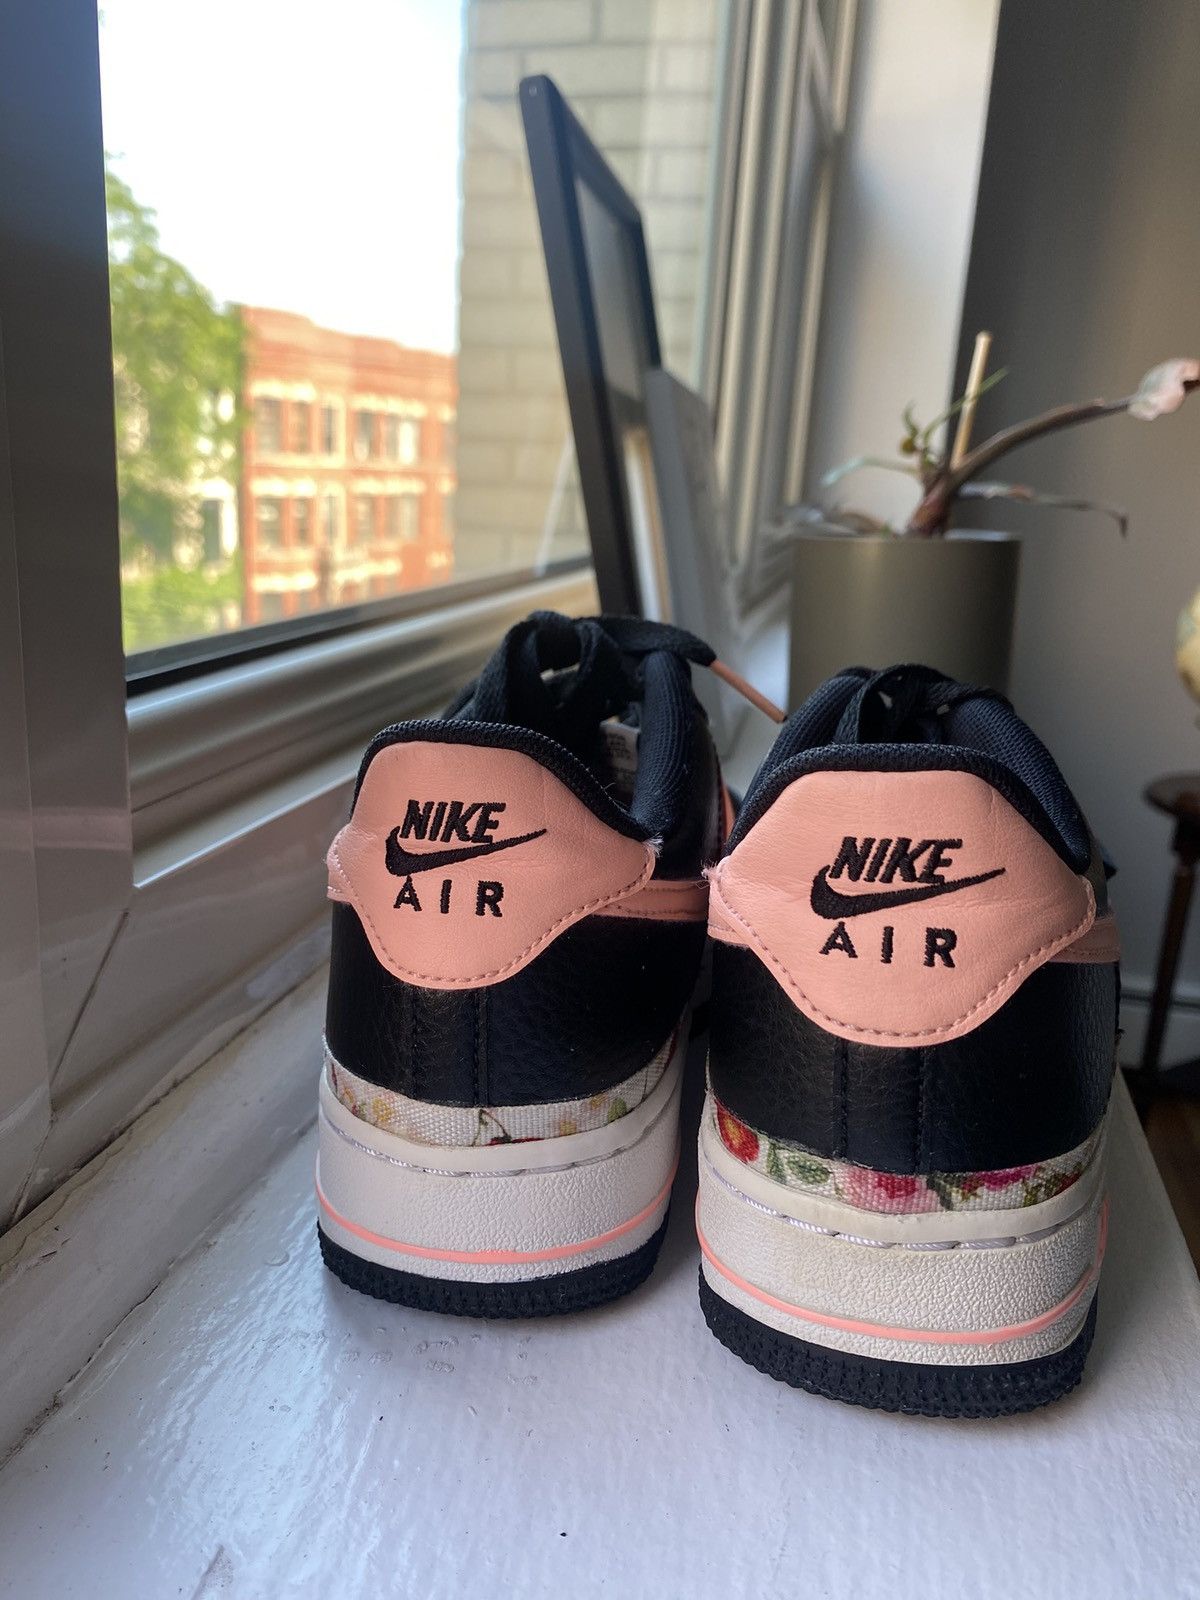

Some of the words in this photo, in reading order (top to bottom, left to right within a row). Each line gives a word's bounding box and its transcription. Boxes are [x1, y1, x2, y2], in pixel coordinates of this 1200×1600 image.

[400, 799, 506, 843] NIKE
[828, 836, 962, 883] NIKE
[393, 875, 504, 917] AIR
[819, 921, 957, 968] AIR
